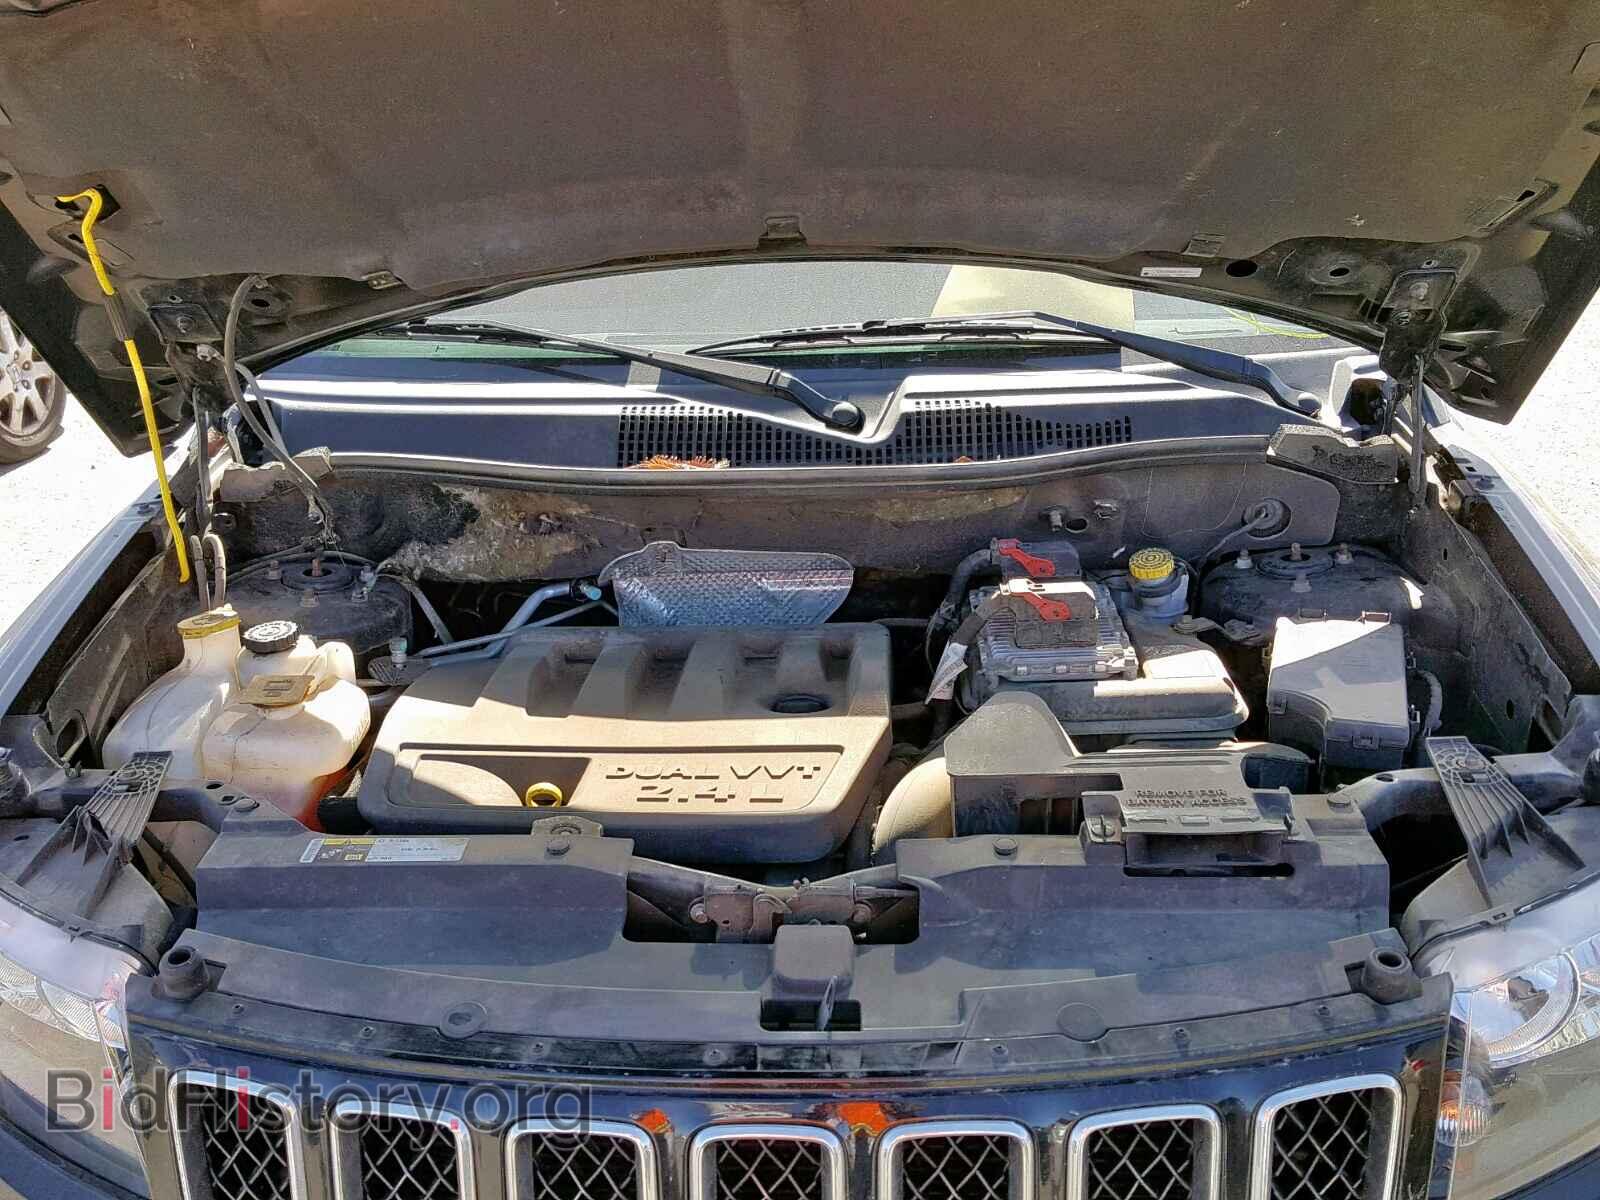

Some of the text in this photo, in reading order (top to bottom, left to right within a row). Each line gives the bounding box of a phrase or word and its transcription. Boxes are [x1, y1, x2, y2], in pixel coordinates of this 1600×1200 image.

[605, 764, 821, 780] DUAL VVT
[636, 784, 784, 803] 2.4L
[1136, 788, 1228, 799] REMOVE FOR
[1127, 797, 1248, 809] BATTERY ACCESS
